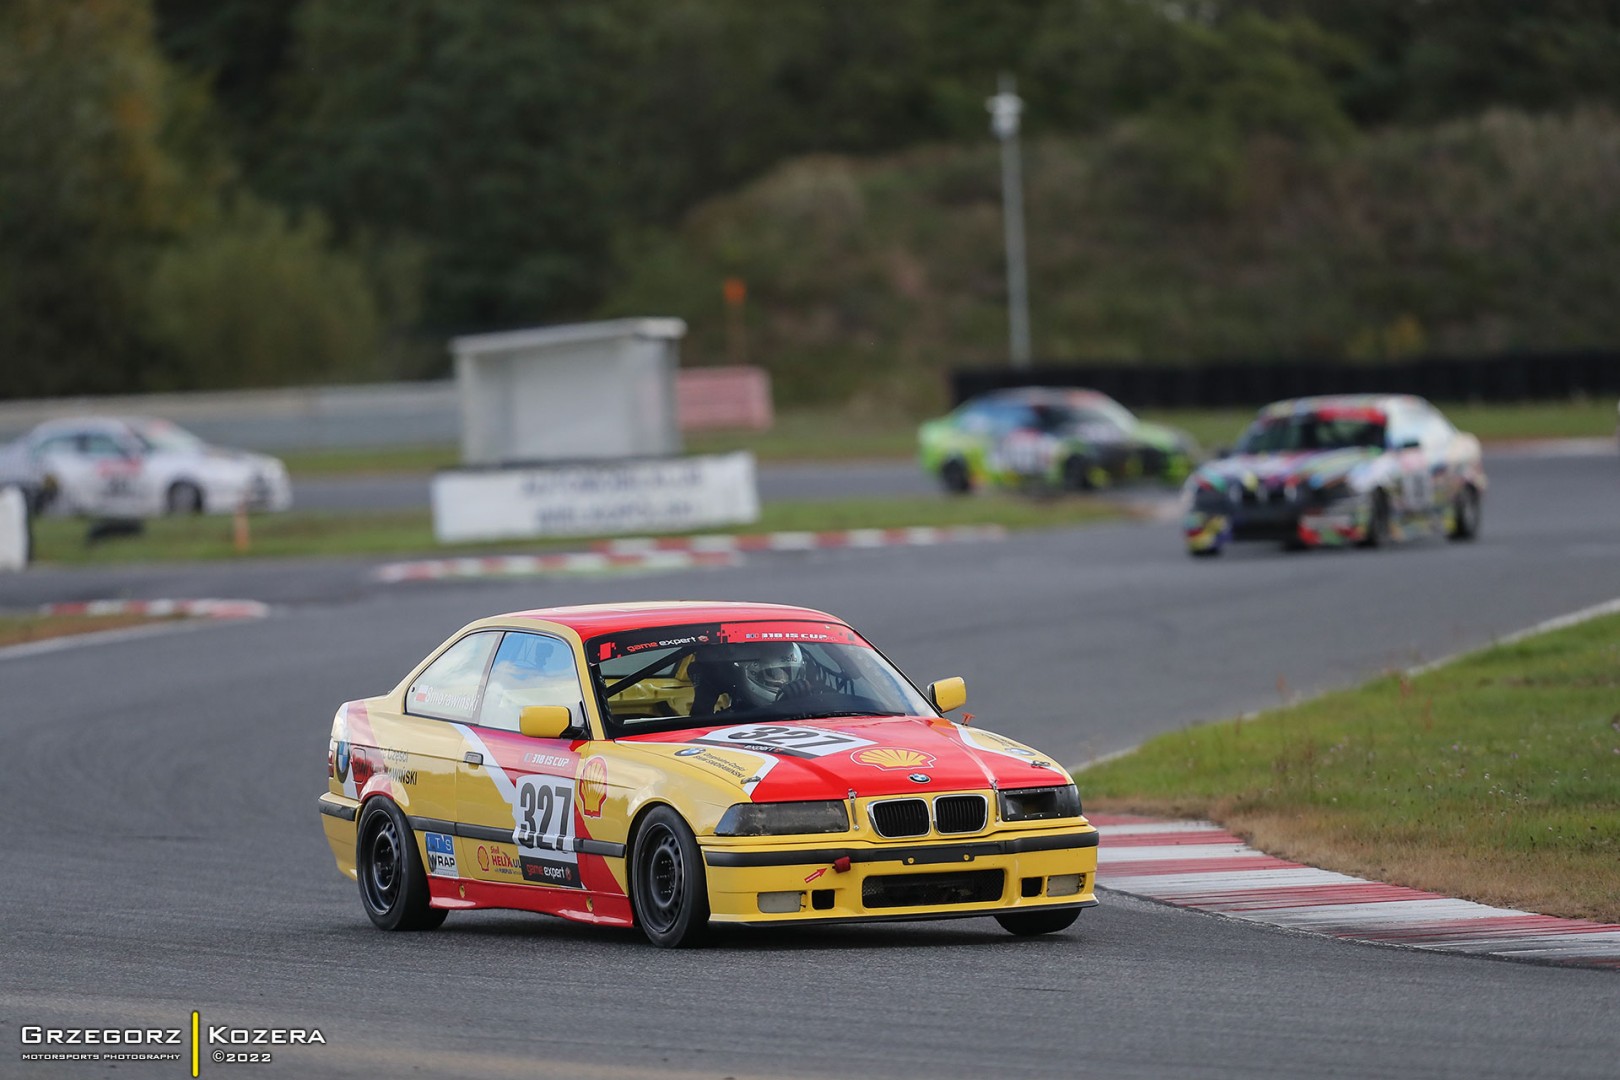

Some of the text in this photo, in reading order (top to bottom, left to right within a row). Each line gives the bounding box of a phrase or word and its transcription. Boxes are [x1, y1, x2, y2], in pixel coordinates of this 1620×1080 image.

[626, 636, 696, 652] game expert
[727, 726, 856, 749] 327
[532, 753, 546, 765] 318
[544, 755, 555, 766] IS
[553, 757, 570, 768] CUP
[518, 782, 572, 852] 327
[428, 853, 455, 872] WRAP
[491, 854, 513, 868] HELIX
[543, 866, 565, 879] expert
